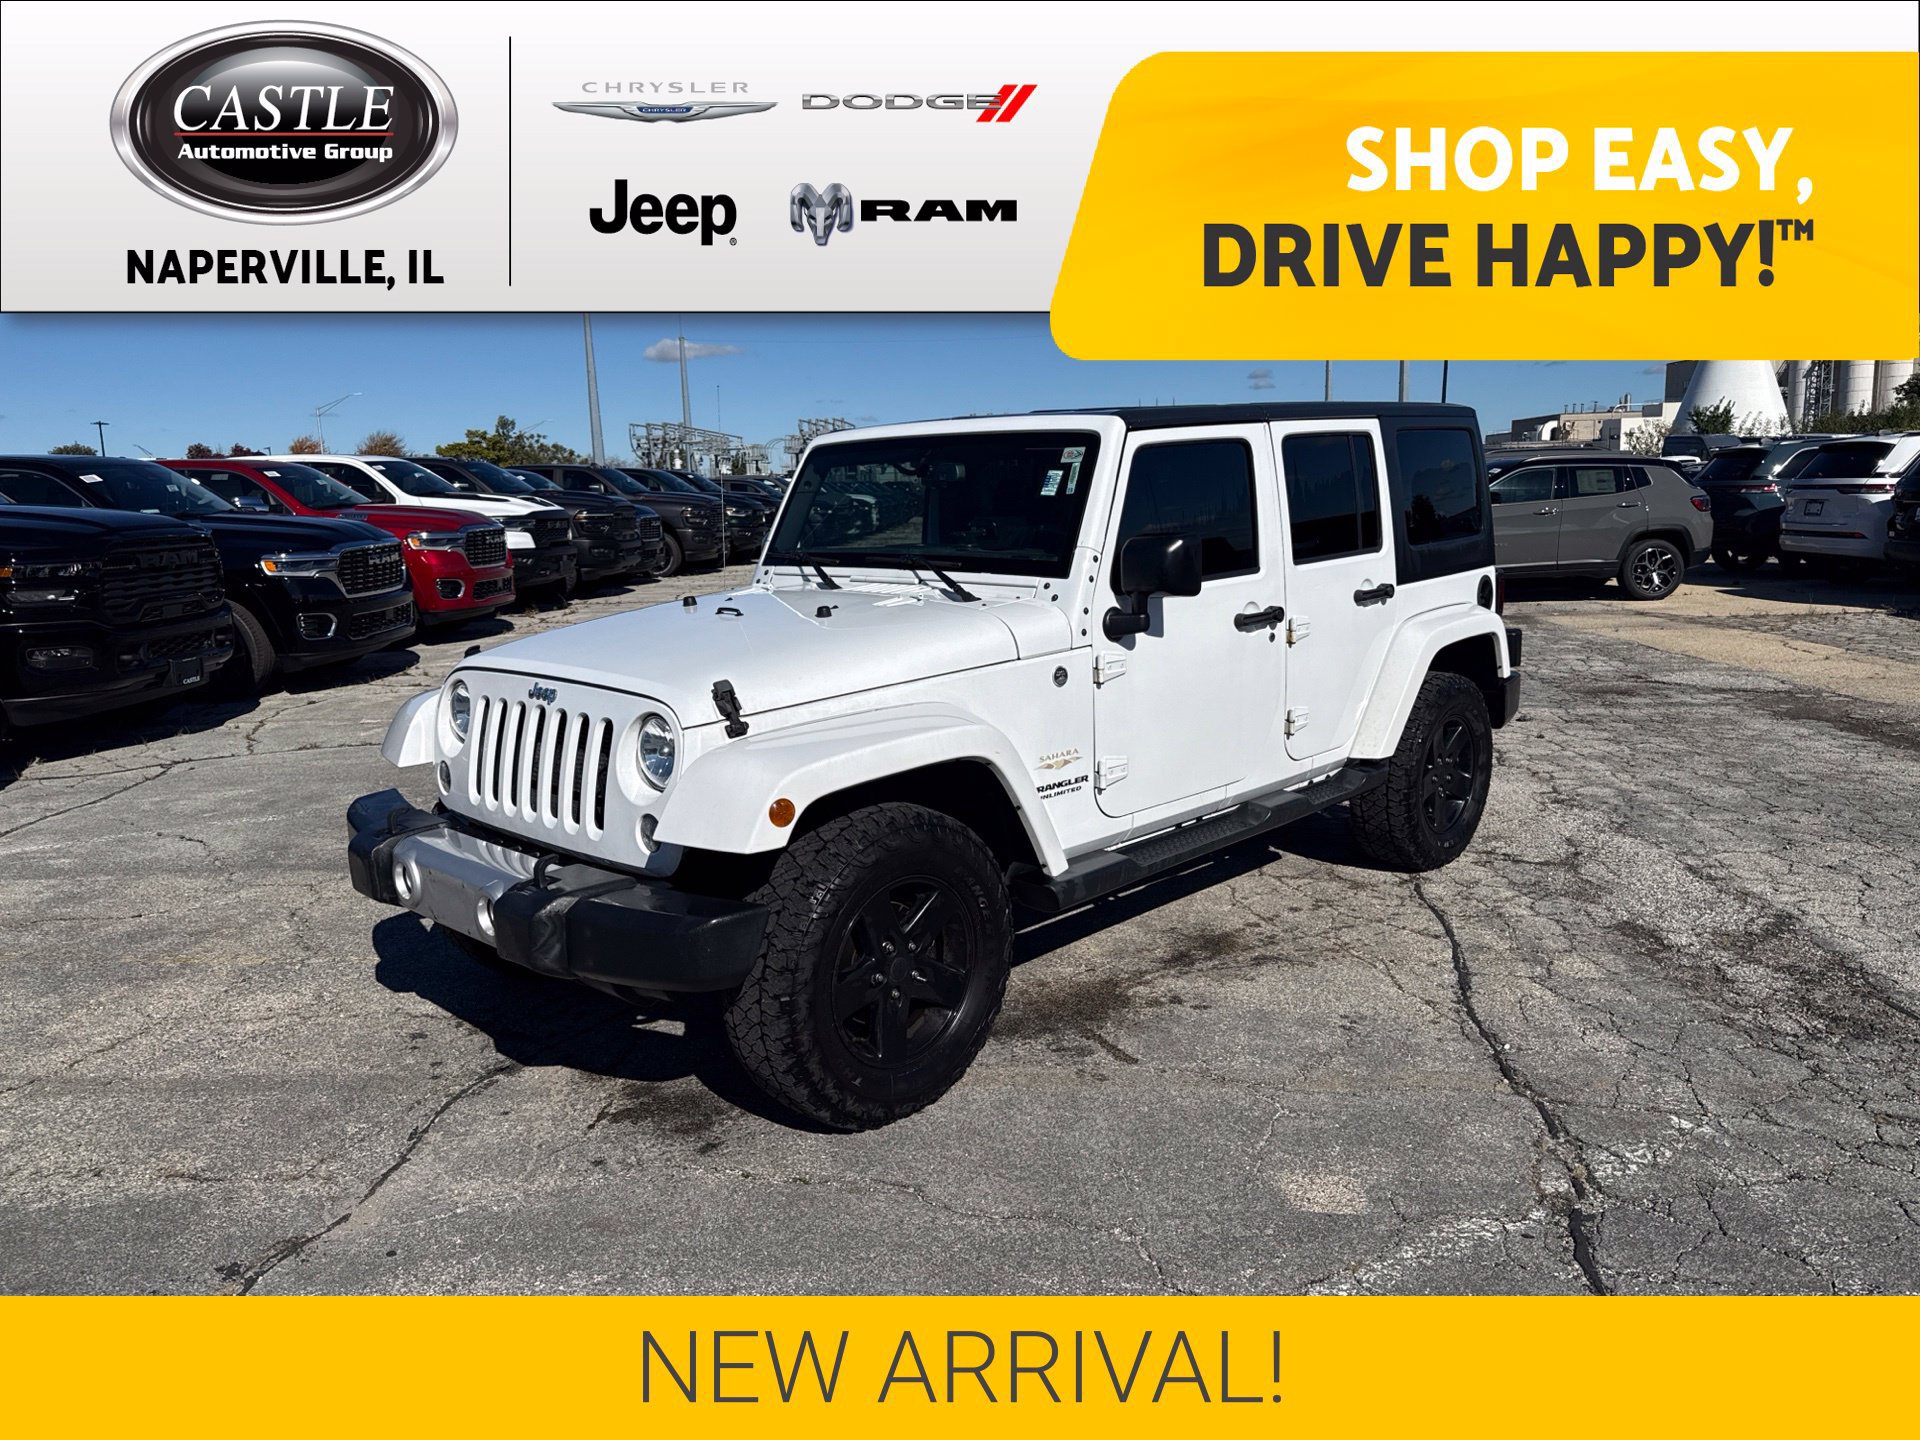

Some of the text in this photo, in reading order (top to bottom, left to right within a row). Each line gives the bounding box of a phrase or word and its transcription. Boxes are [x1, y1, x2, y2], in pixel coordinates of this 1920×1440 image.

[528, 682, 558, 706] Jeep
[1039, 748, 1079, 761] SAHARA
[1036, 775, 1089, 793] RANGLER
